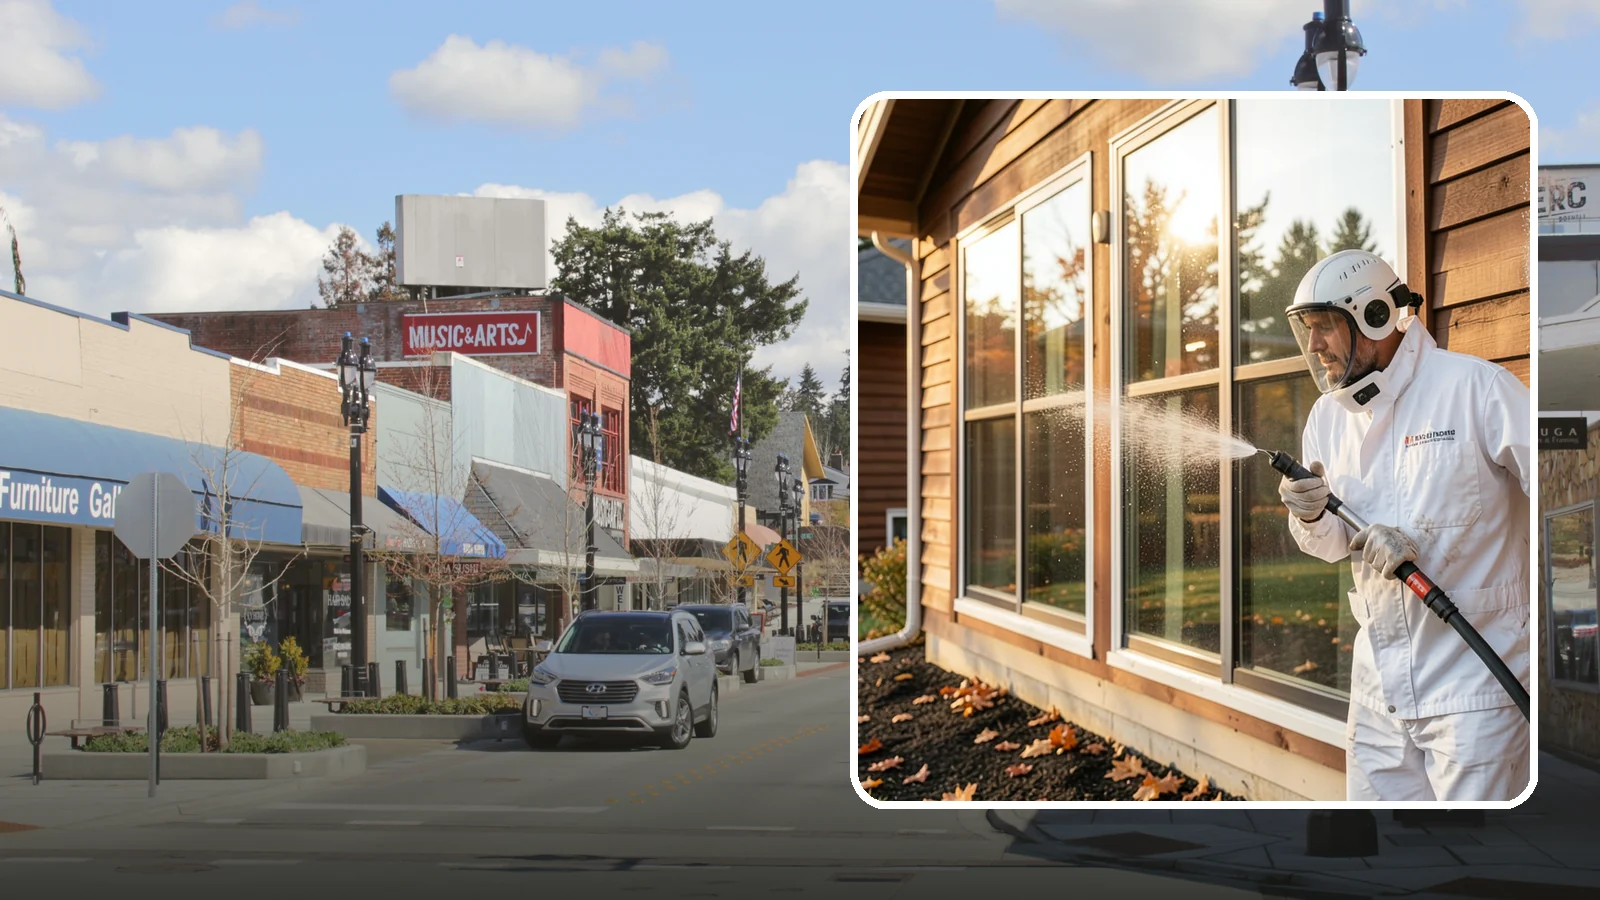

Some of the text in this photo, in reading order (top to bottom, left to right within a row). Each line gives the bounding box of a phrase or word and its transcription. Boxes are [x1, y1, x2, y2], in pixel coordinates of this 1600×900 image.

[409, 323, 519, 349] MUSIC&ARTS
[1540, 427, 1578, 436] UGA
[0, 471, 122, 519] Furniture Gal
